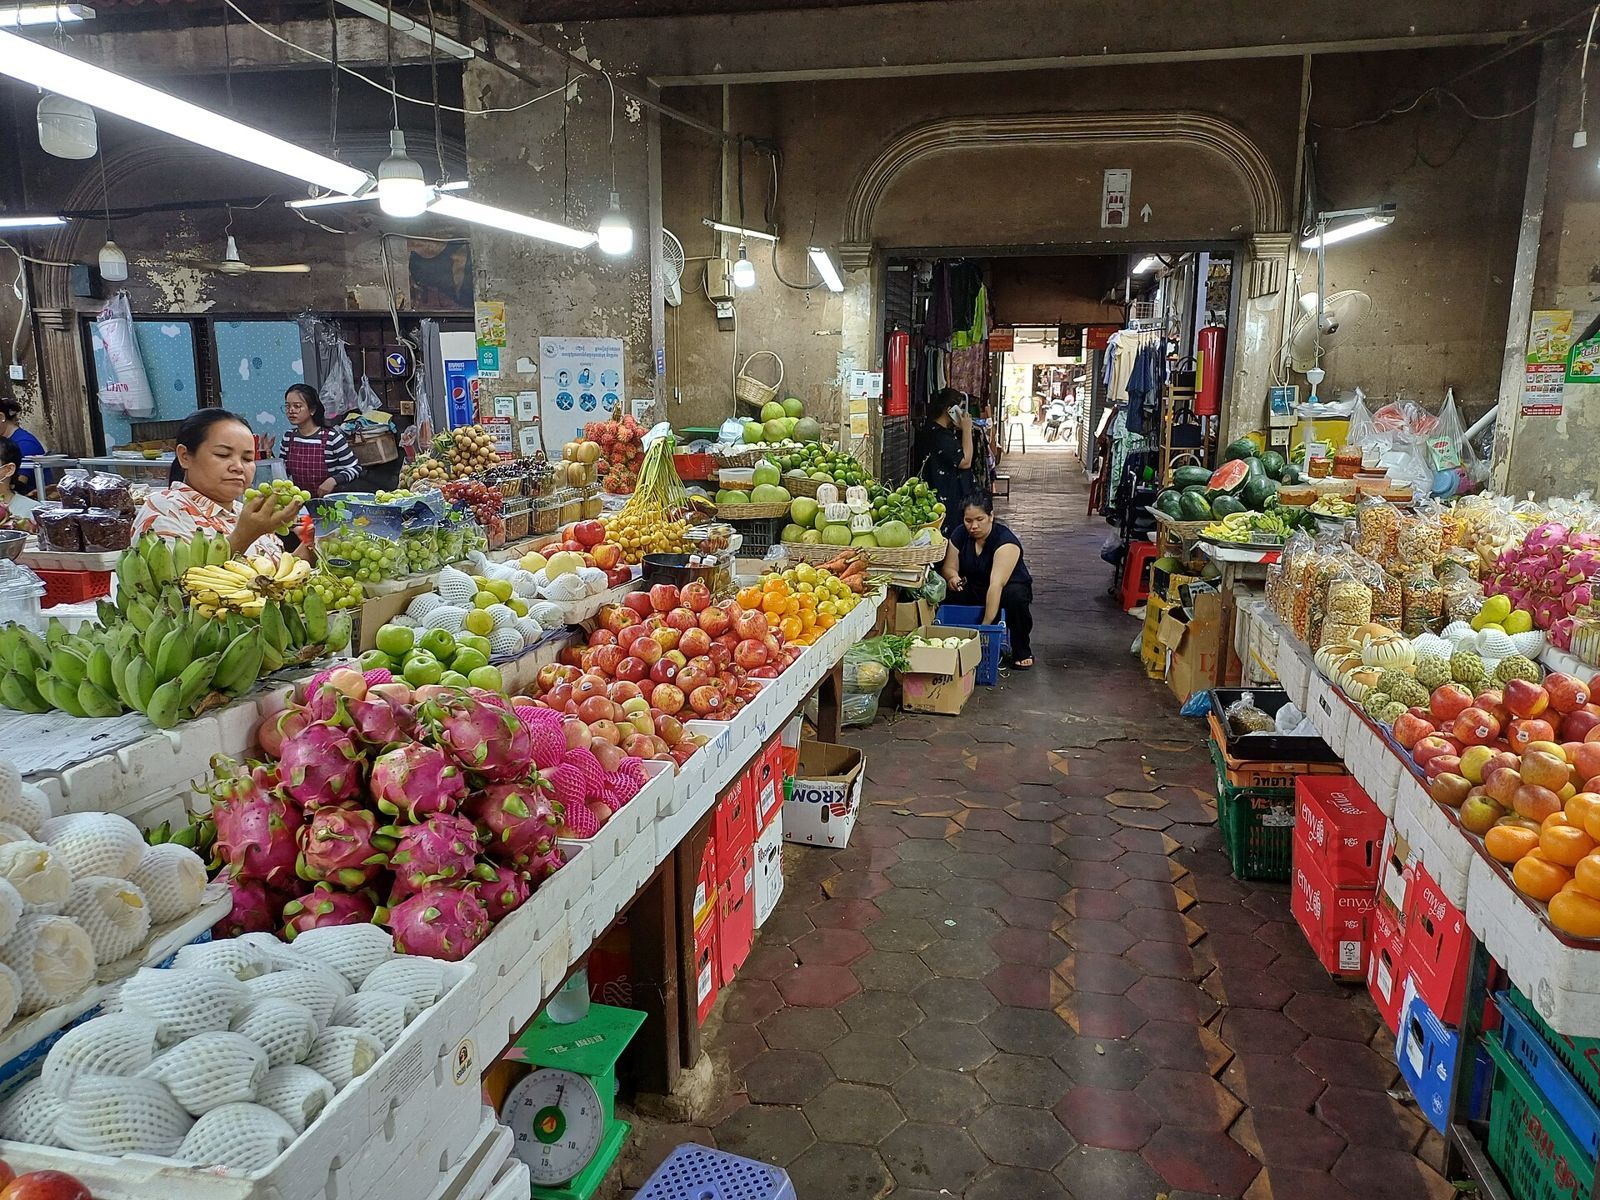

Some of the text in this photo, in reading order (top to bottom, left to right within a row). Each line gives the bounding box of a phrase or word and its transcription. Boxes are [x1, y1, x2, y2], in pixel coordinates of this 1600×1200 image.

[1301, 803, 1319, 841] envy
[1297, 868, 1314, 913] envy
[1338, 897, 1374, 914] envy
[523, 1098, 533, 1106] 25
[580, 1106, 586, 1116] 5
[518, 1133, 528, 1142] 20
[567, 1141, 577, 1150] 10
[540, 1158, 549, 1167] 15
